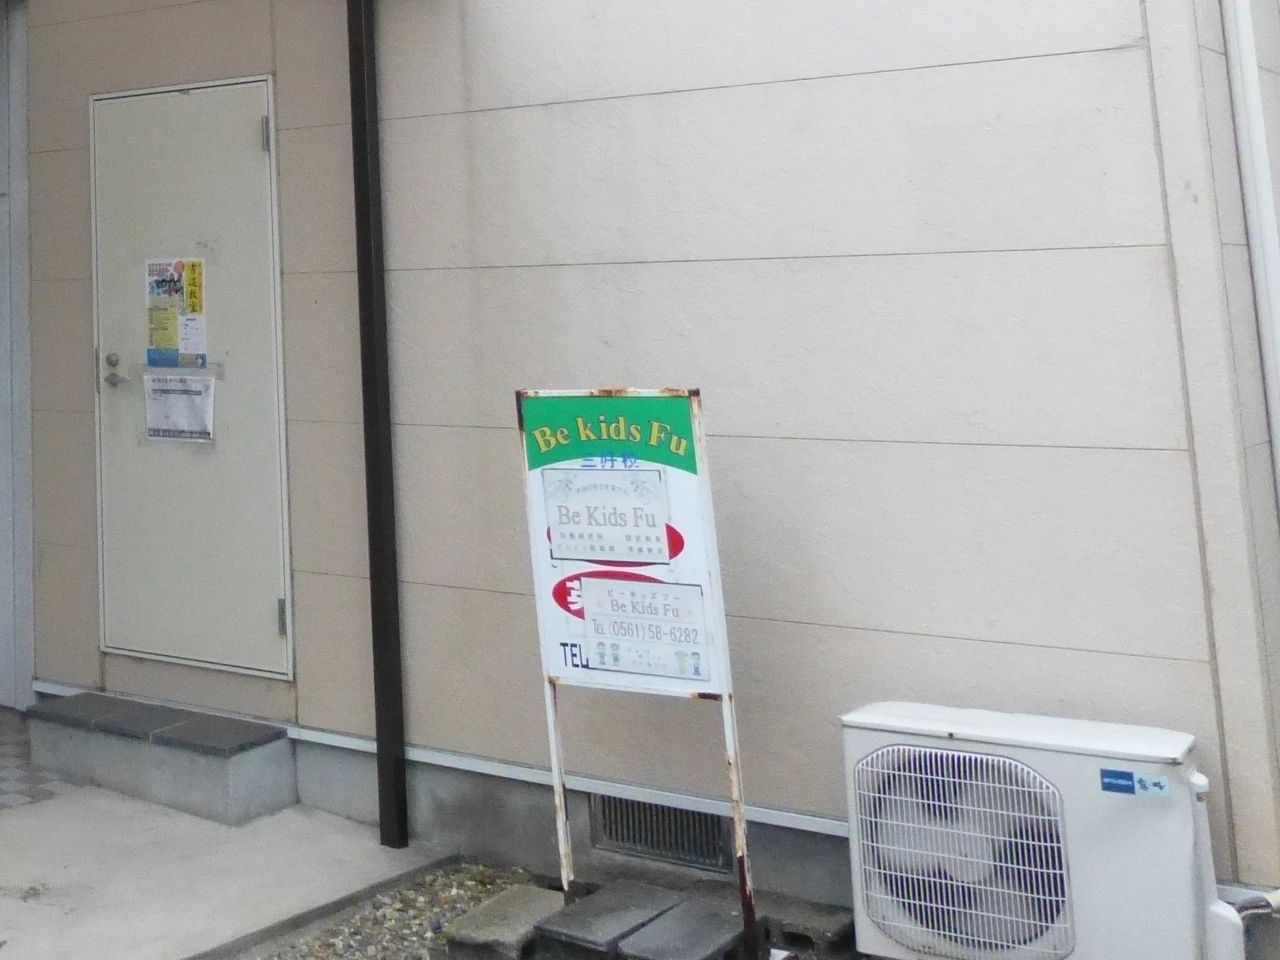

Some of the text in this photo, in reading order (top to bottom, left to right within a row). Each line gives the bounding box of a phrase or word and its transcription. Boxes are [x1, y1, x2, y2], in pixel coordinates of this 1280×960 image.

[532, 415, 689, 456] Be kids Fu
[557, 505, 657, 528] Be Kids Fu
[610, 599, 680, 618] Be Kids Fu
